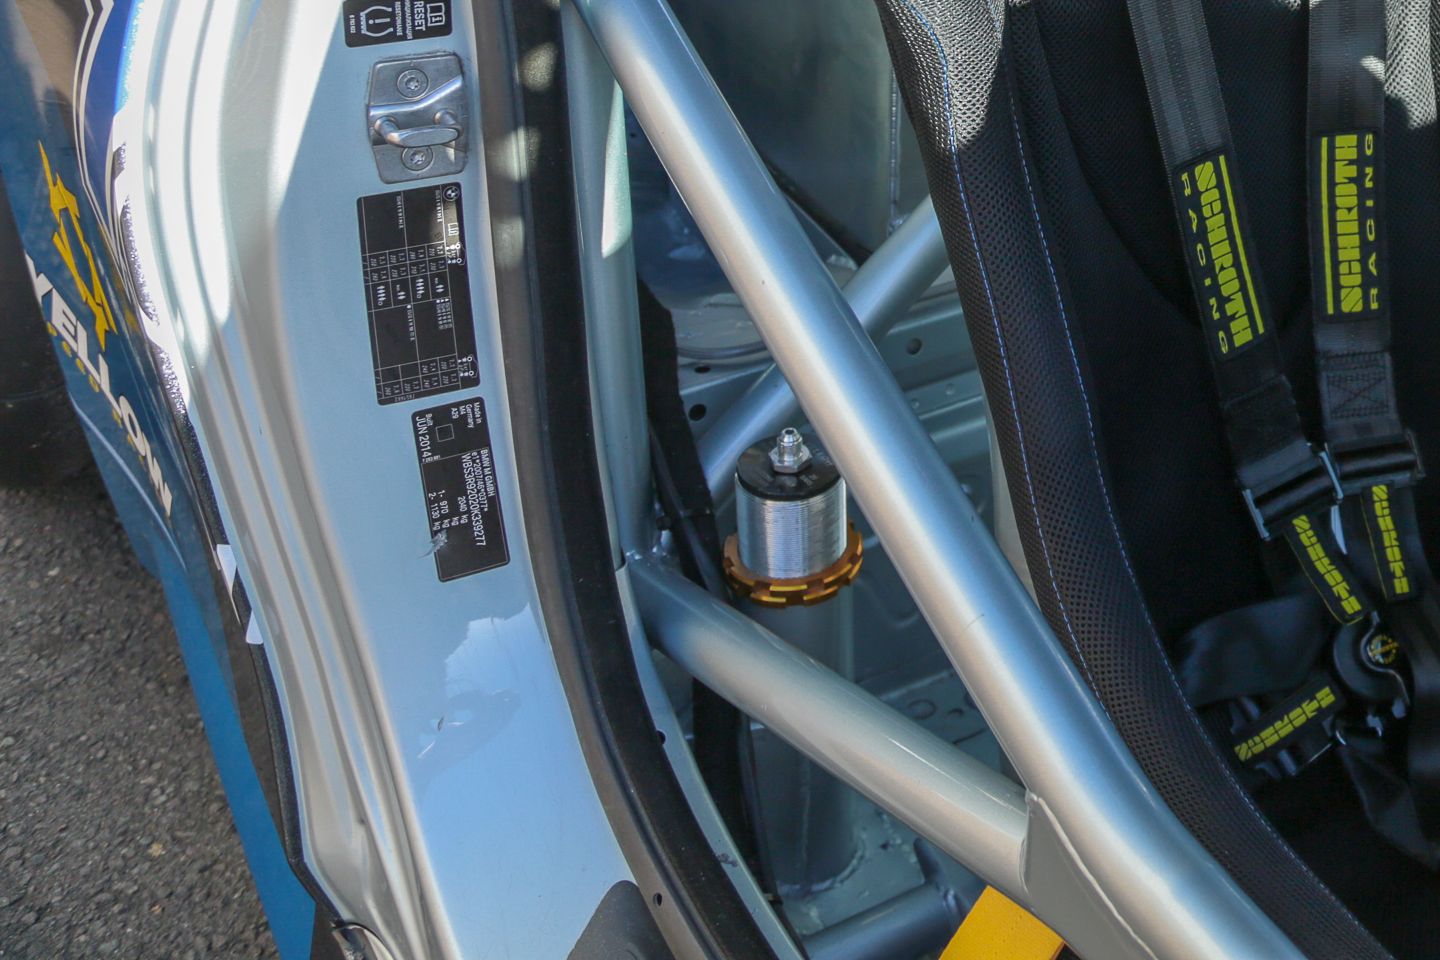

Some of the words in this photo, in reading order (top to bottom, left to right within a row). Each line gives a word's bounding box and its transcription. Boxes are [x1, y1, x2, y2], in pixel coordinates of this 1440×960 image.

[414, 1, 426, 31] RESET
[1334, 134, 1364, 313] SCHROTH
[1365, 133, 1379, 310] RACING
[1181, 172, 1229, 354] RACING
[1194, 161, 1253, 348] SCHROTH
[25, 253, 172, 517] YELLOW
[425, 413, 433, 426] Built
[450, 407, 458, 419] A29
[459, 406, 466, 415] M4
[465, 404, 474, 428] Germany
[416, 416, 425, 434] JUN
[419, 435, 432, 458] 2014
[480, 449, 489, 467] BMW
[485, 475, 495, 497] GMBH
[429, 503, 439, 518] 1130
[439, 500, 448, 513] 970
[457, 496, 467, 512] 2040
[432, 521, 441, 530] kg
[441, 518, 451, 528] kg
[450, 516, 460, 526] kg
[459, 514, 469, 523] kg
[1371, 485, 1410, 594] SCHROTH
[1292, 514, 1362, 615] SCHROTH
[1234, 686, 1335, 762] SCHROTH
